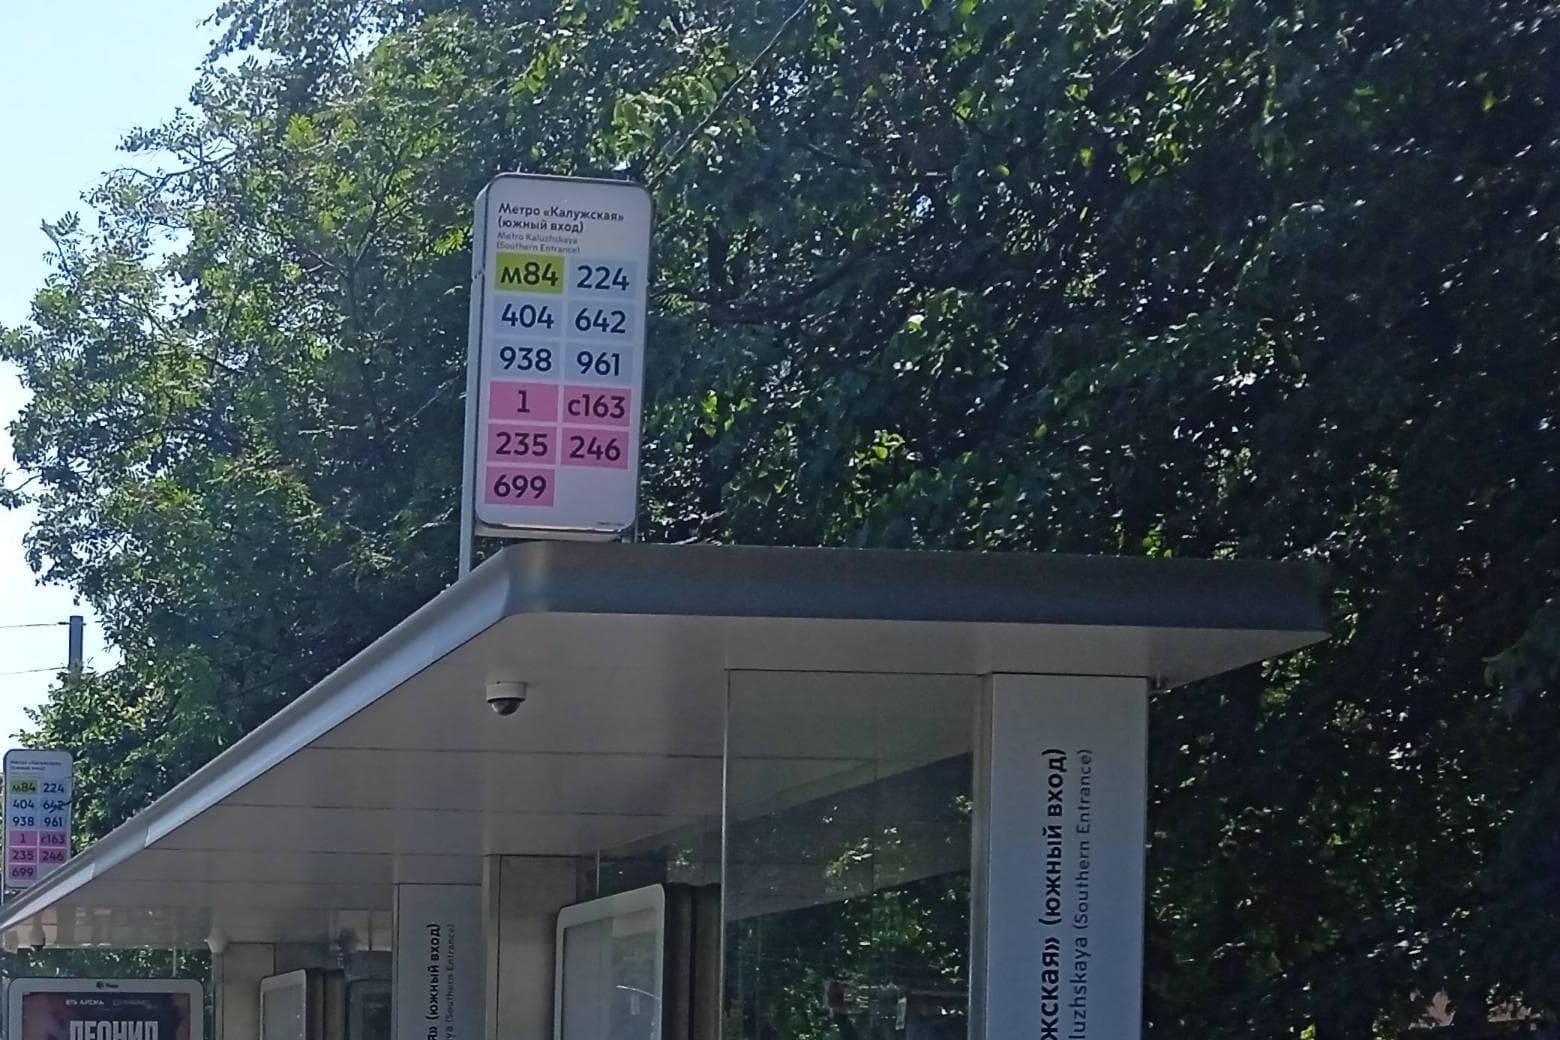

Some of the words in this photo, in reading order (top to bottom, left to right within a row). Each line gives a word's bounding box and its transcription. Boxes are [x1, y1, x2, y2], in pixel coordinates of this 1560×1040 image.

[498, 202, 541, 217] Метро
[543, 206, 624, 222] «Калужская»
[498, 215, 547, 230] (южный
[551, 220, 584, 233] вход)
[496, 232, 524, 241] Metro
[577, 264, 629, 291] 224
[501, 303, 554, 329] 404
[575, 308, 626, 334] 642
[499, 346, 552, 372] 938
[577, 351, 620, 377] 961
[517, 390, 530, 413] 1
[568, 393, 625, 419] с163
[495, 431, 548, 457] 235
[569, 435, 621, 462] 246
[493, 475, 547, 499] 699
[43, 783, 65, 793] 224
[1041, 748, 1067, 817] вход)
[1076, 748, 1093, 834] Entrance)
[12, 799, 35, 809] 404
[12, 816, 35, 827] 938
[44, 817, 63, 827] 961
[20, 834, 26, 844] 1
[12, 851, 34, 861] 235
[42, 851, 65, 861] 246
[12, 867, 34, 878] 699
[1038, 825, 1062, 926] (южный
[1072, 840, 1090, 930] (Southern
[426, 923, 441, 962] вход)
[446, 923, 456, 971] Entrance)
[426, 966, 440, 1021] (южный
[445, 973, 455, 1023] (Southern
